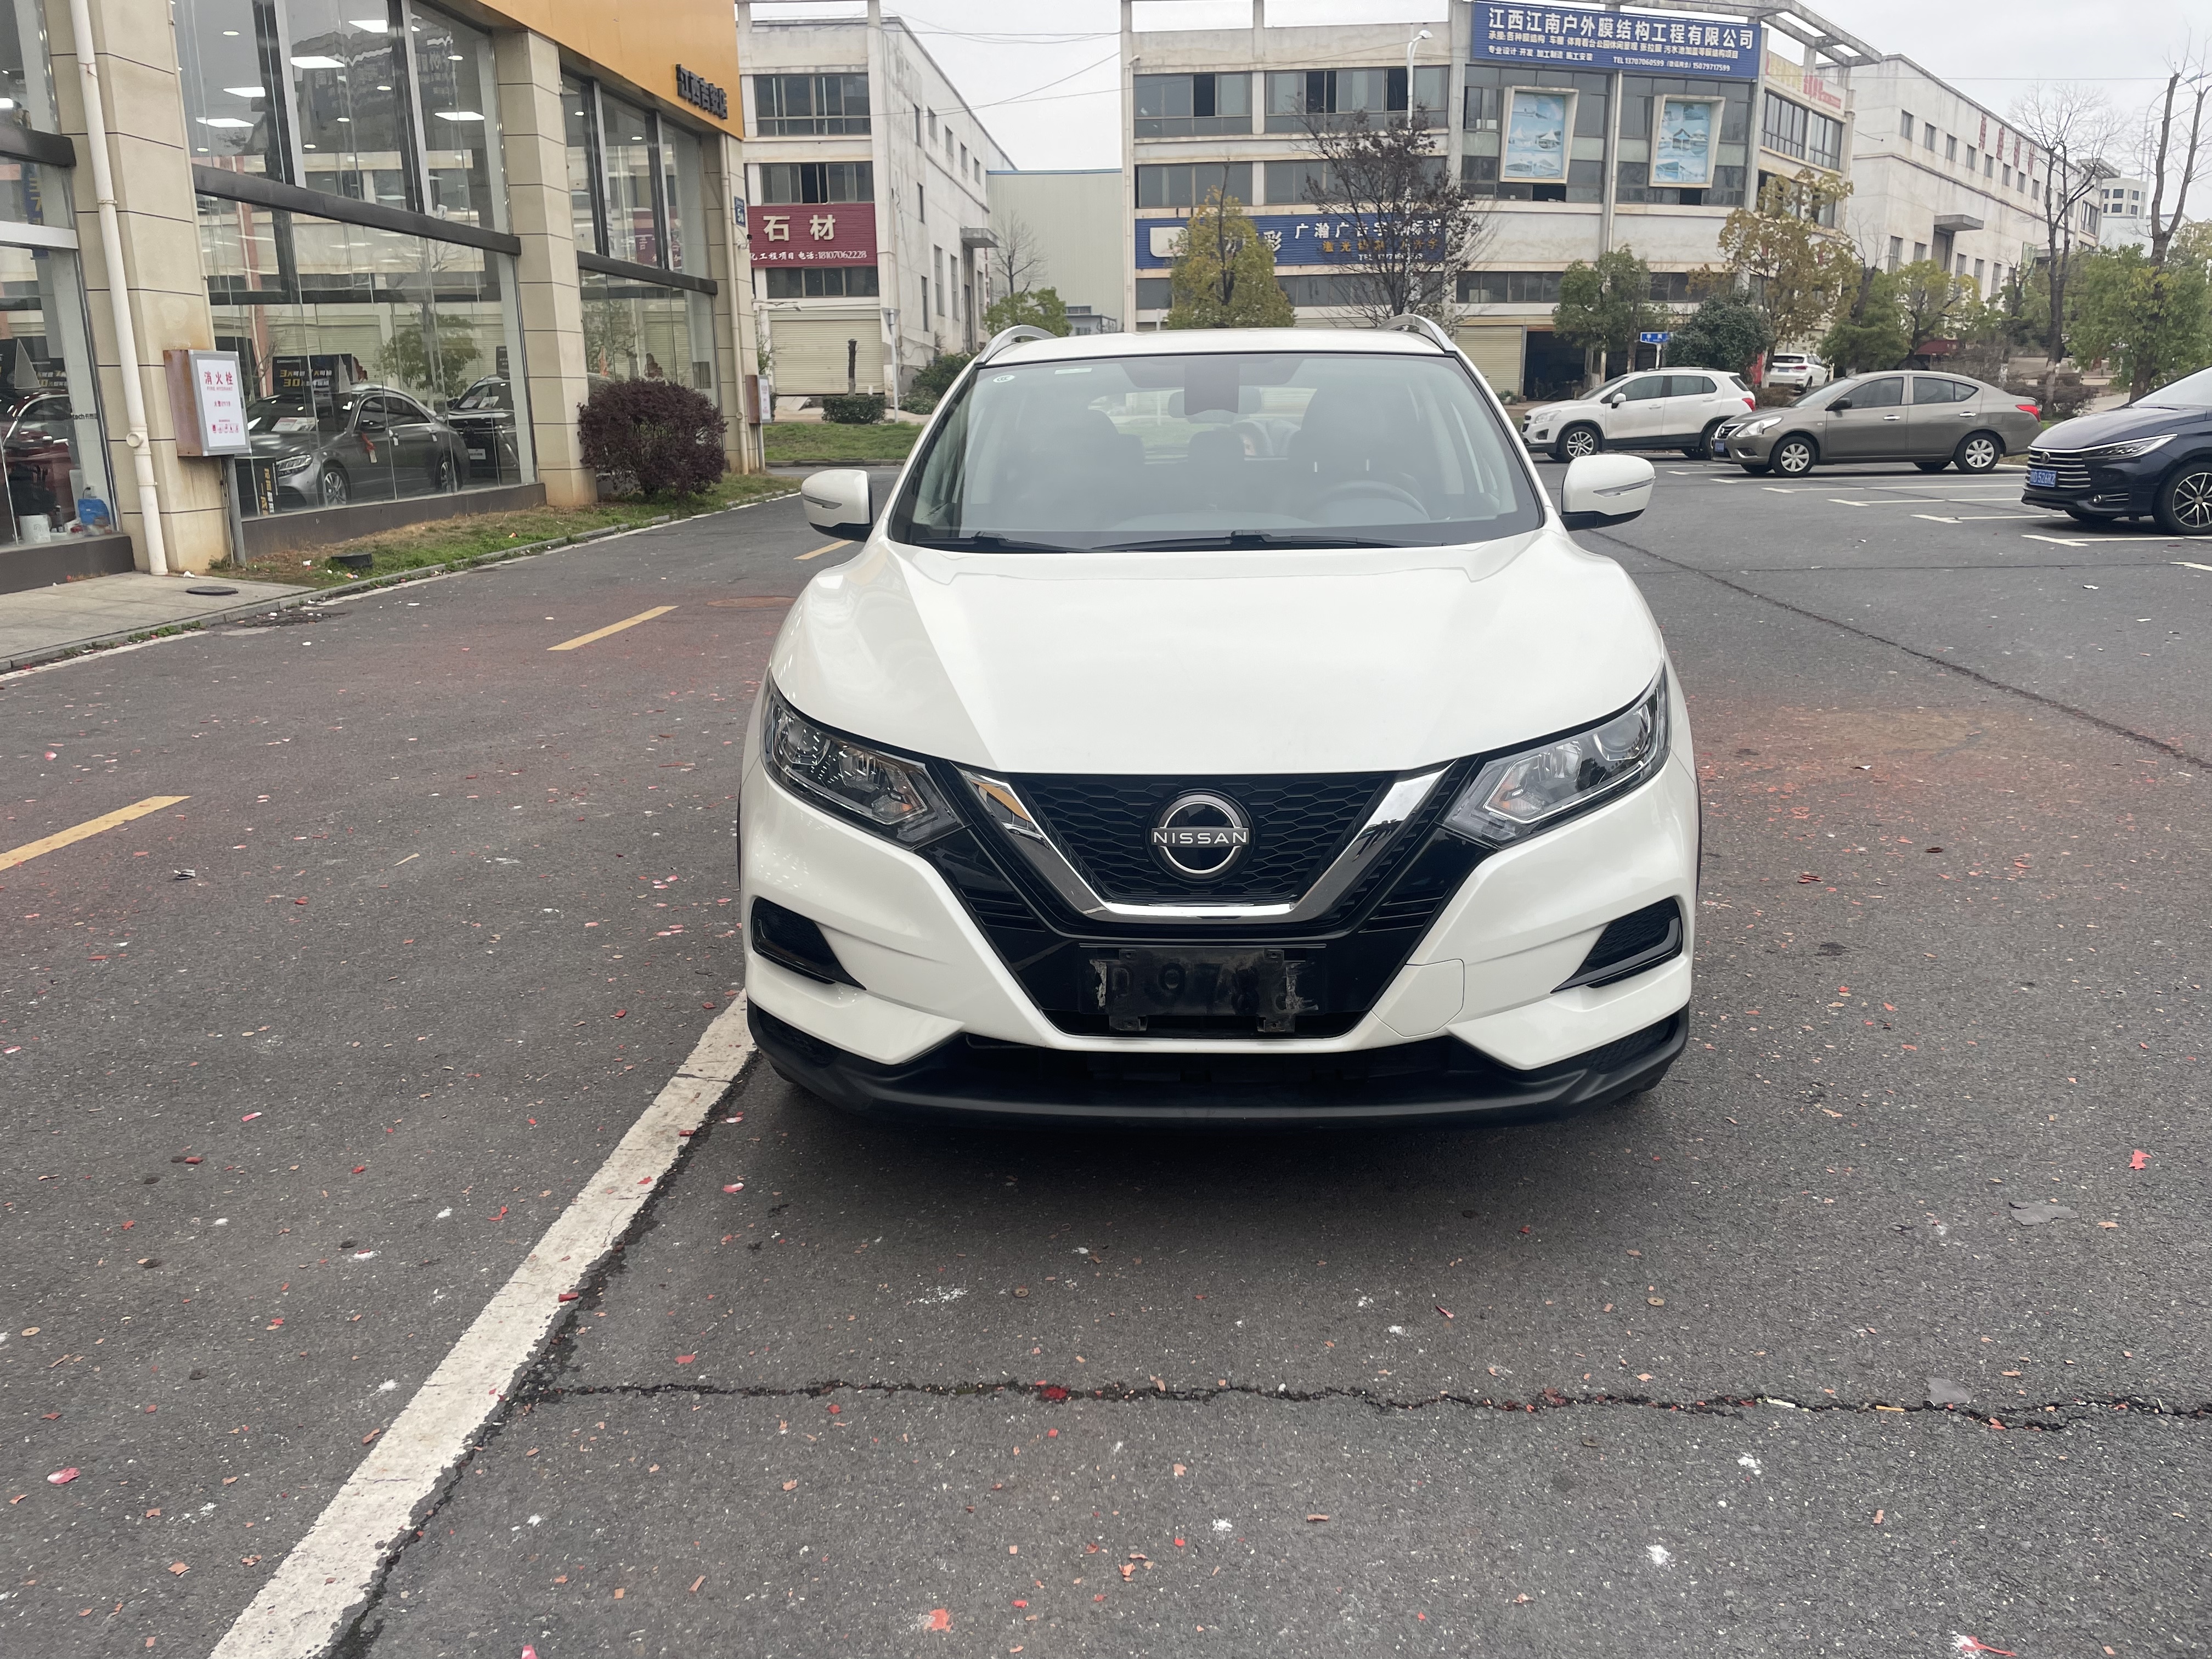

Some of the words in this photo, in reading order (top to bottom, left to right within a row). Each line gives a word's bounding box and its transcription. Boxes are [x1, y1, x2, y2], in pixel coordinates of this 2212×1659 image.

[1488, 7, 1753, 49] 江西江南户外膜结构工程有限公司
[763, 214, 837, 241] 石材
[204, 370, 234, 385] 消火栓
[1154, 832, 1247, 844] NISSAN
